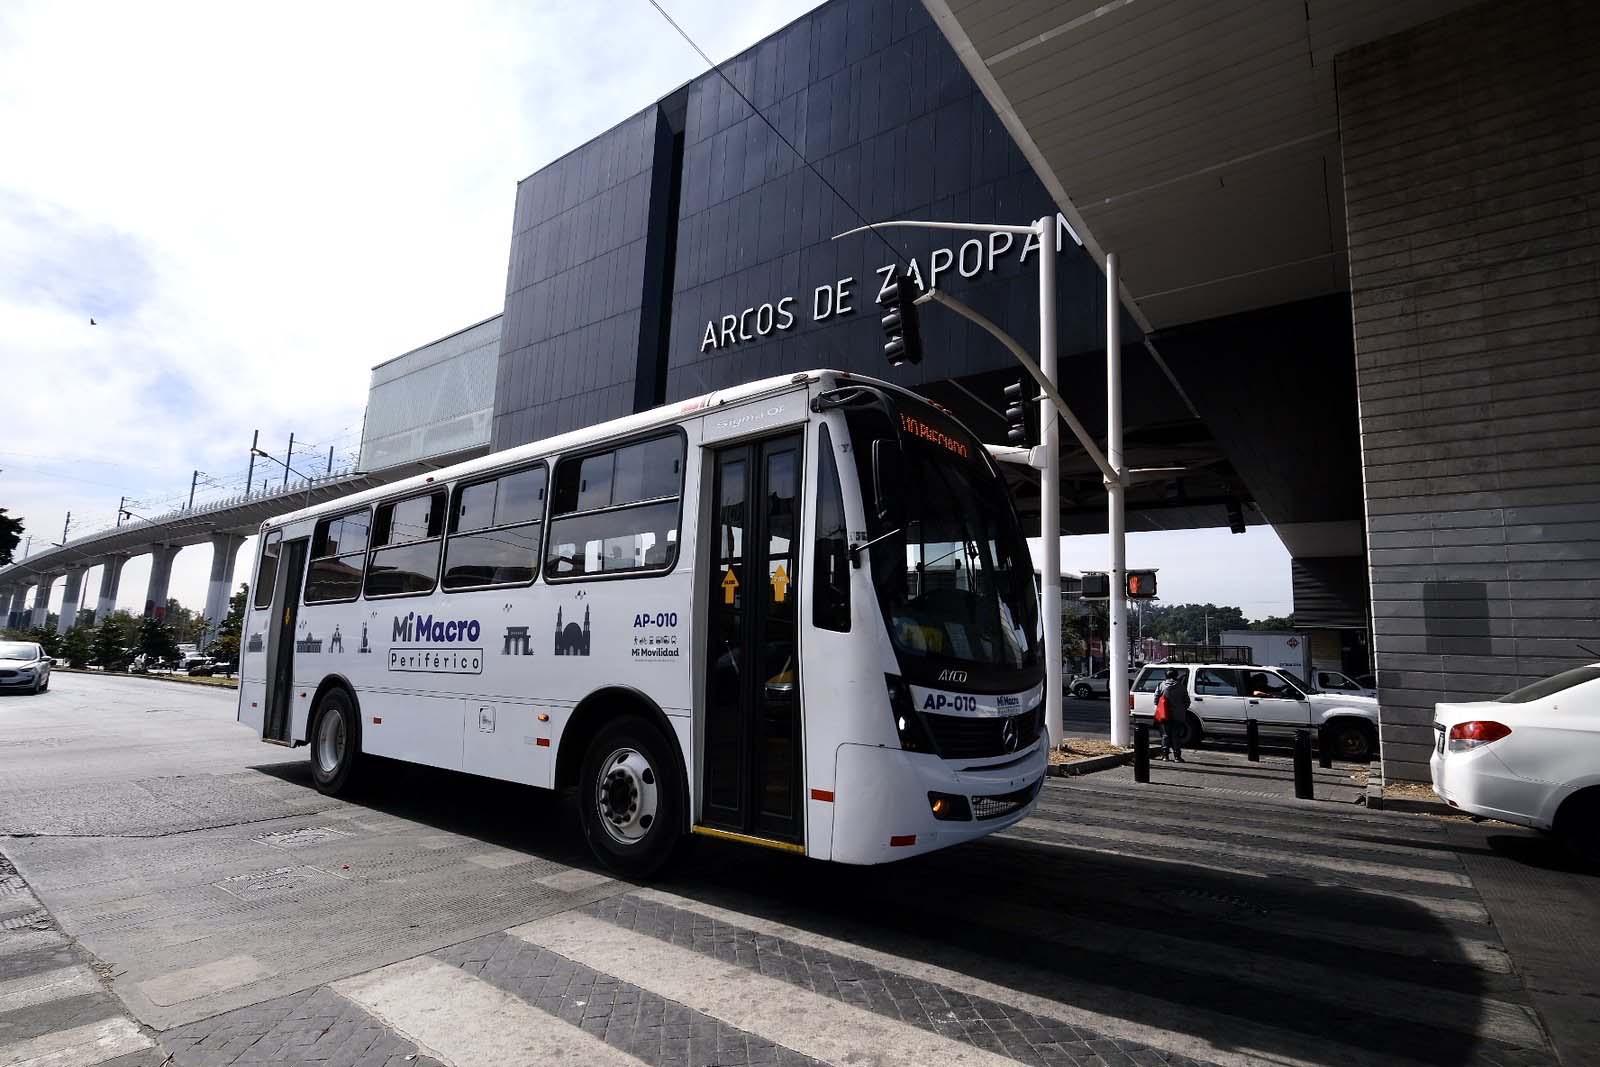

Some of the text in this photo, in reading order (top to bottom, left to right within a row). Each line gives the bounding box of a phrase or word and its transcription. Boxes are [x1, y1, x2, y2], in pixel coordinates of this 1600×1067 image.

[700, 296, 795, 353] ARCOS
[813, 276, 853, 321] DE
[633, 612, 678, 628] AP-010
[391, 652, 479, 669] Periférico
[923, 693, 977, 712] AP-010
